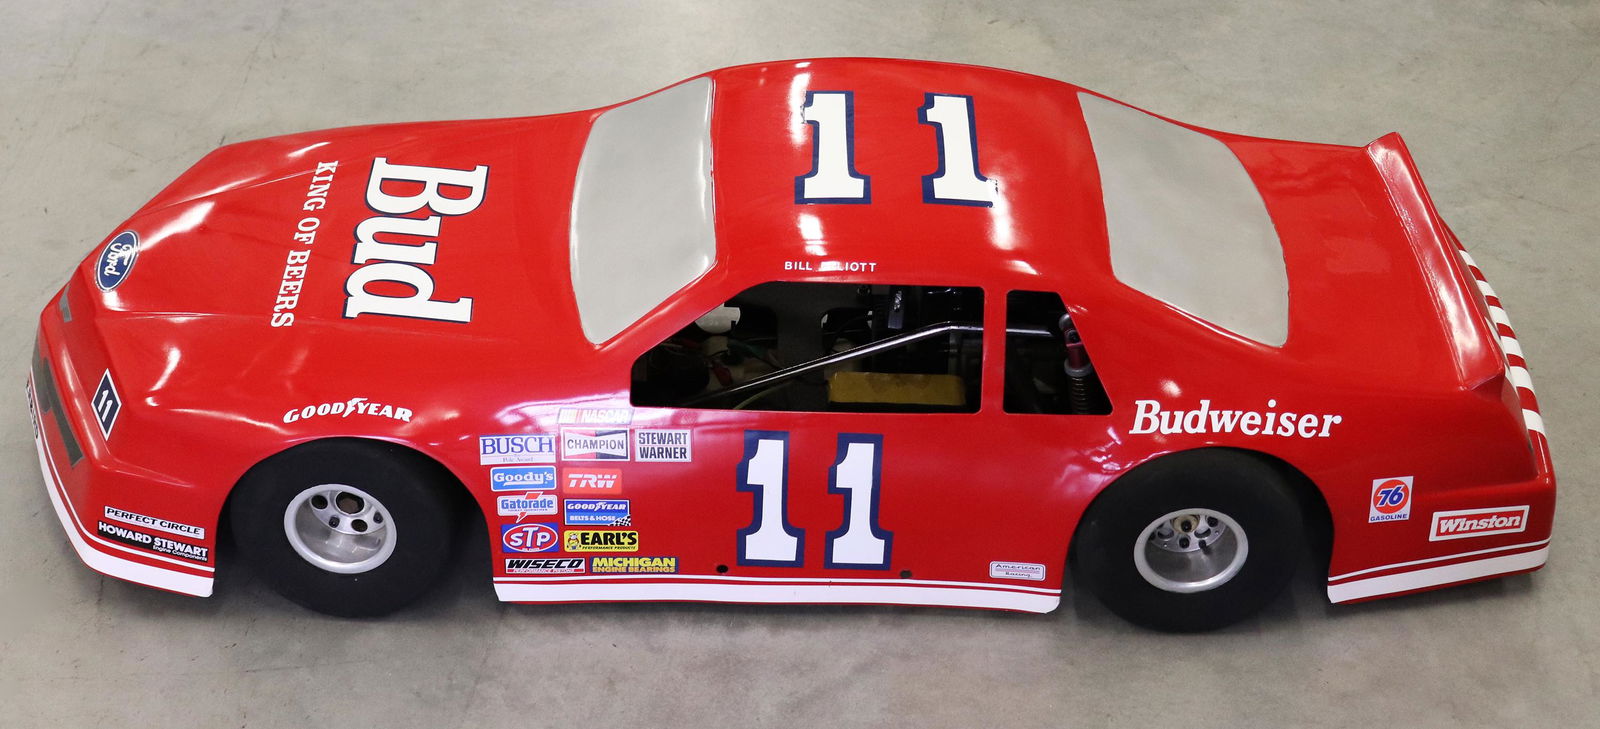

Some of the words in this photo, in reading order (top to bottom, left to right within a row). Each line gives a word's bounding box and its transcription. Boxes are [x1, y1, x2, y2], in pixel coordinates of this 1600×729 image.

[302, 160, 339, 212] KING
[293, 217, 321, 245] OF
[342, 157, 490, 324] Bud
[104, 243, 133, 276] Ford
[783, 261, 813, 271] BILL
[819, 260, 877, 272] LIOTT
[270, 249, 312, 328] BEERS
[97, 389, 113, 423] 11
[283, 397, 413, 424] GOODYEAR
[1128, 398, 1343, 439] Budweiser
[480, 436, 555, 455] BUSCH
[567, 439, 625, 450] CHAMPION
[638, 432, 688, 445] STEWART
[639, 446, 687, 459] WARNER
[493, 471, 554, 487] Goody's
[568, 474, 617, 488] TRW
[501, 499, 554, 509] Gatorade
[736, 430, 894, 571] 11
[1376, 484, 1405, 508] 76
[567, 502, 627, 511] GOODYEAR
[106, 507, 159, 526] PERFECT
[159, 520, 201, 535] CIRCLE
[1370, 513, 1408, 522] GASOLINE
[1439, 515, 1521, 534] Winston
[98, 521, 152, 544] HOWARD
[153, 537, 209, 557] STEWART
[509, 526, 551, 548] STP
[580, 532, 637, 546] EARL'S
[152, 545, 173, 554] Engine
[507, 559, 584, 569] WISECO
[592, 557, 676, 567] MICHIGAN
[995, 563, 1041, 571] American
